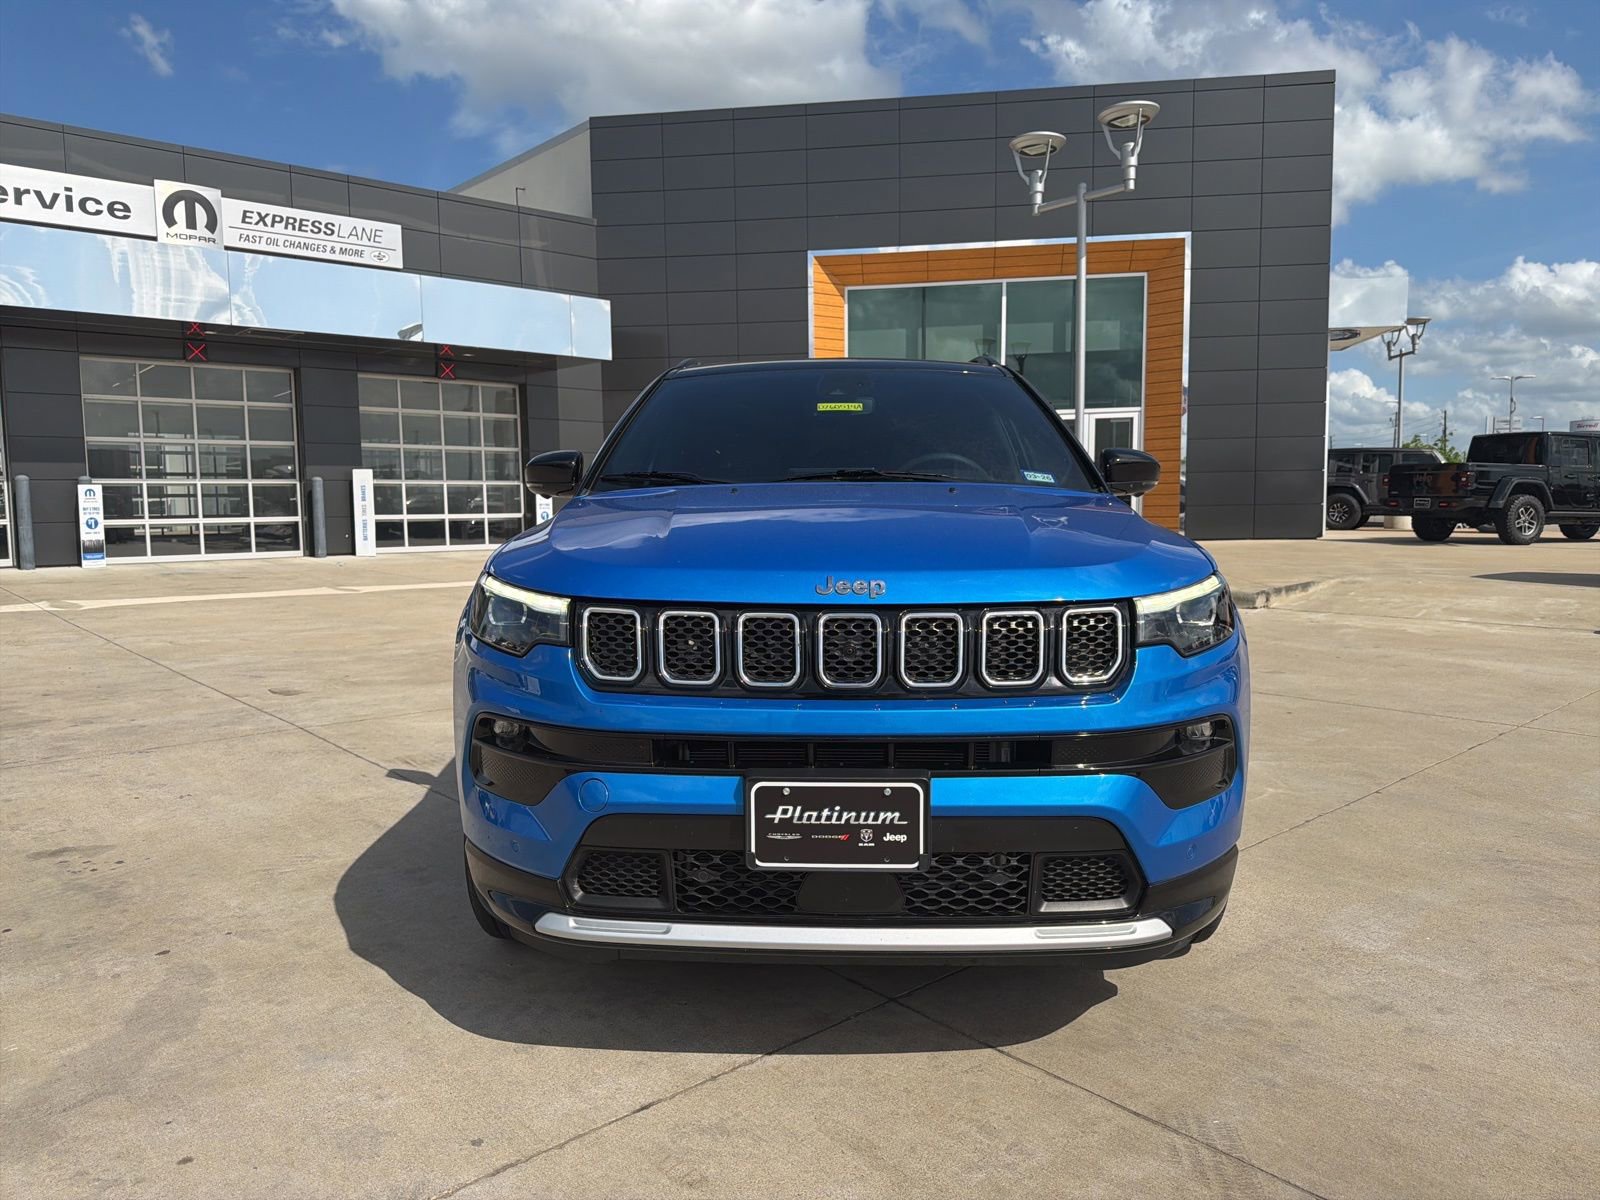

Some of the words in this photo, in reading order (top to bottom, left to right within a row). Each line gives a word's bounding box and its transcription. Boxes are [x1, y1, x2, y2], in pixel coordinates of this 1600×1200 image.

[166, 232, 217, 244] MOPAR
[238, 233, 264, 245] FAST
[265, 236, 281, 248] OIL
[283, 239, 328, 254] CHANGES
[329, 245, 336, 255] &
[338, 246, 365, 259] MORE
[815, 575, 886, 599] Jeep
[764, 805, 909, 825] Platinum
[883, 832, 908, 843] Jeep
